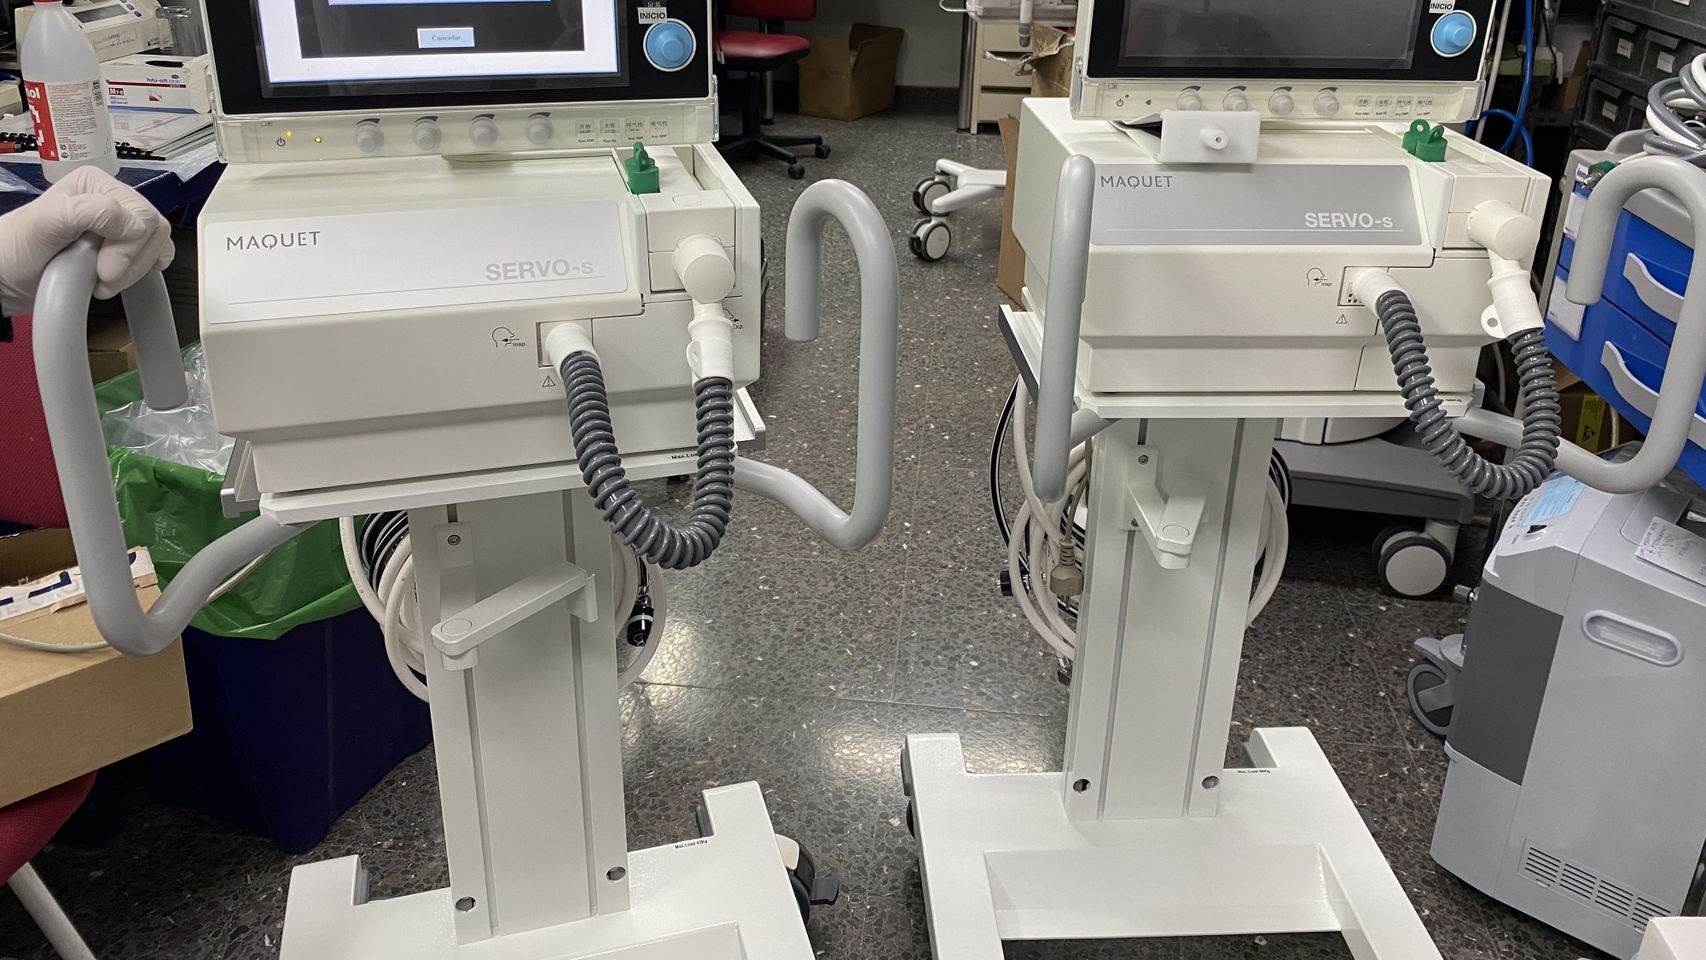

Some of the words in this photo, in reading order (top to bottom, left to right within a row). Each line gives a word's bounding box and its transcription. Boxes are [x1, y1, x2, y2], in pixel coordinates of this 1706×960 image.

[639, 12, 666, 20] INICIO
[1100, 175, 1173, 189] MAQUET
[1304, 212, 1394, 228] SERVO-s
[226, 230, 321, 251] MAQUET
[485, 258, 595, 281] SERVO-s
